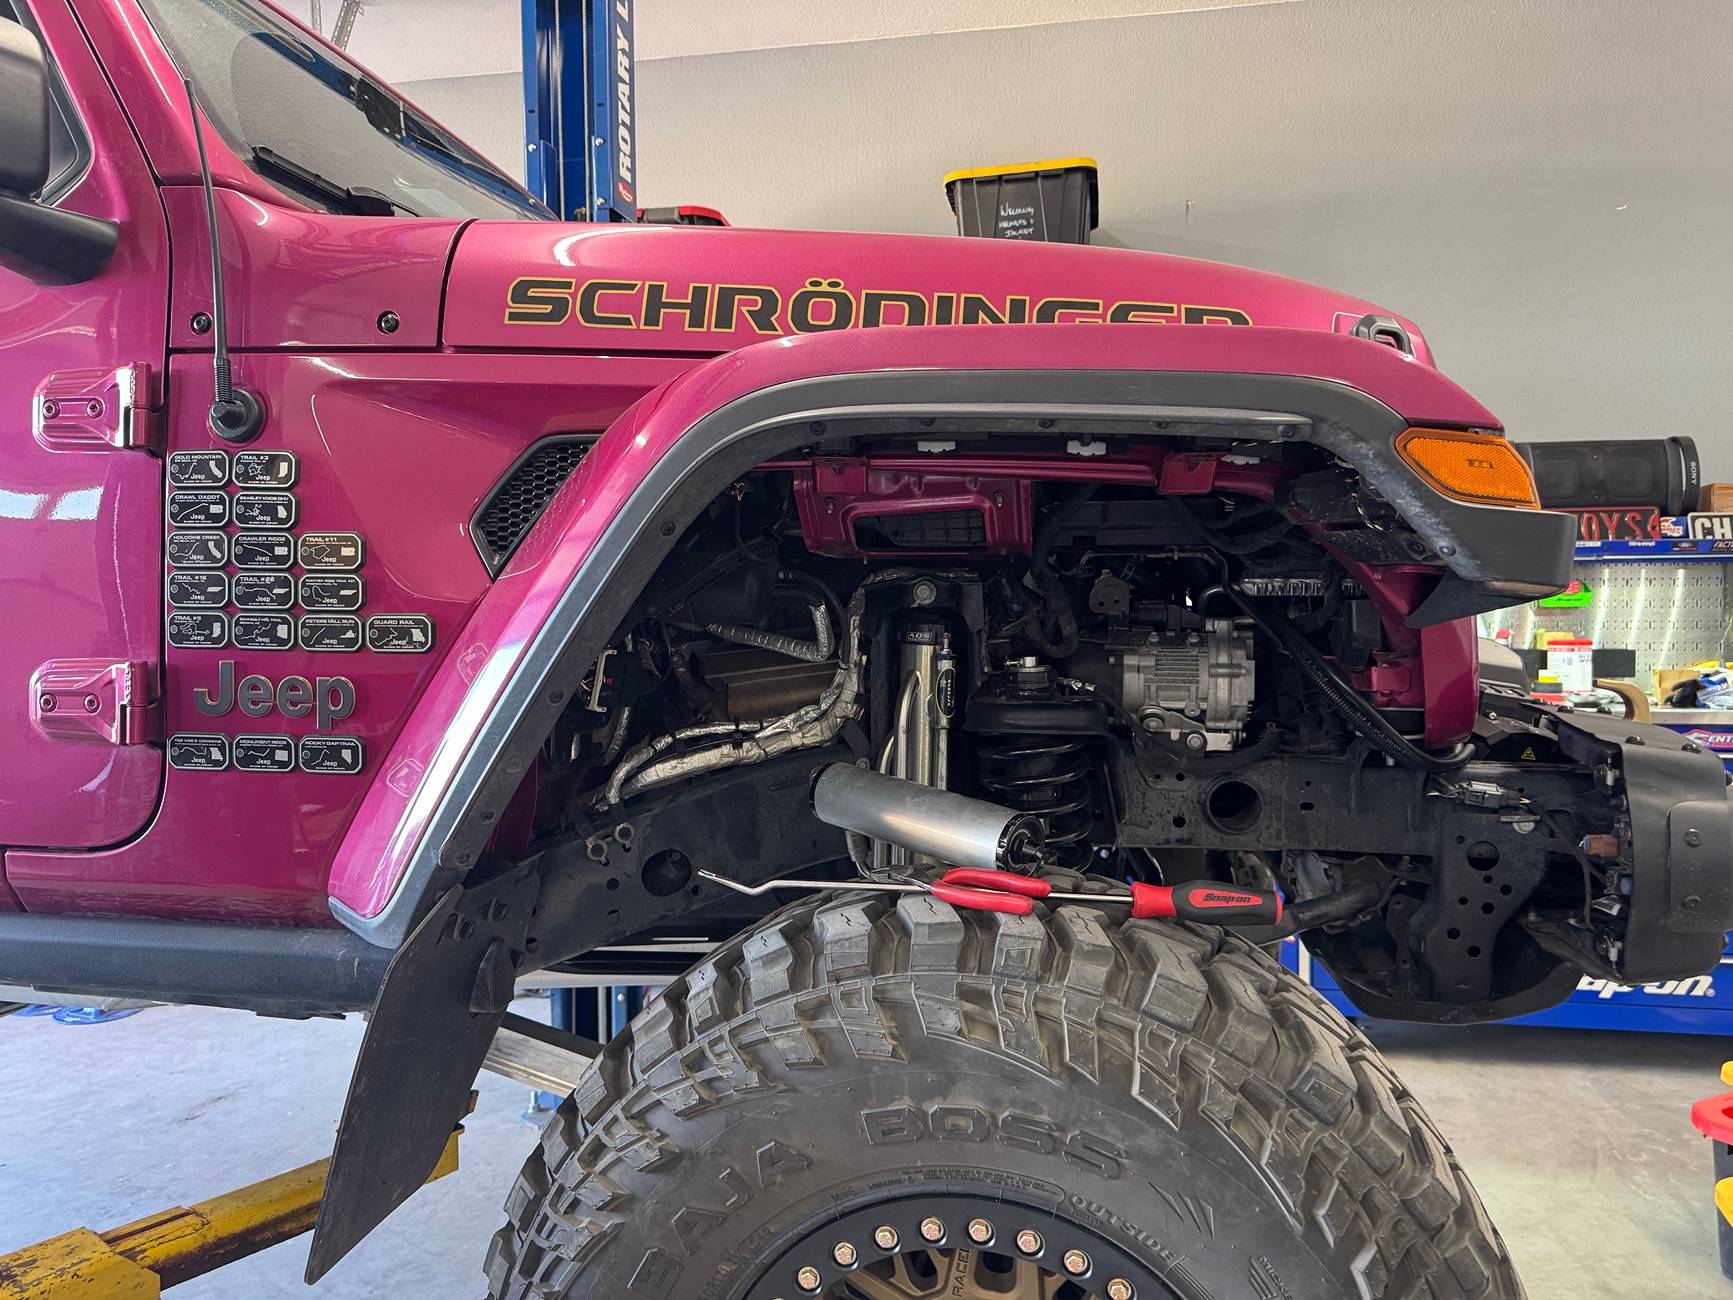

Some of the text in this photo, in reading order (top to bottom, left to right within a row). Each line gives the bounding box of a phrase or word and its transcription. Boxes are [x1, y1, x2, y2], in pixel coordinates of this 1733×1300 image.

[616, 24, 632, 183] ROTARY
[194, 660, 356, 729] Jeep
[1204, 894, 1252, 904] Snap-on
[627, 1140, 813, 1300] BAJA
[861, 1103, 1130, 1179] BOSS
[1070, 1193, 1176, 1262] OUTSIDE
